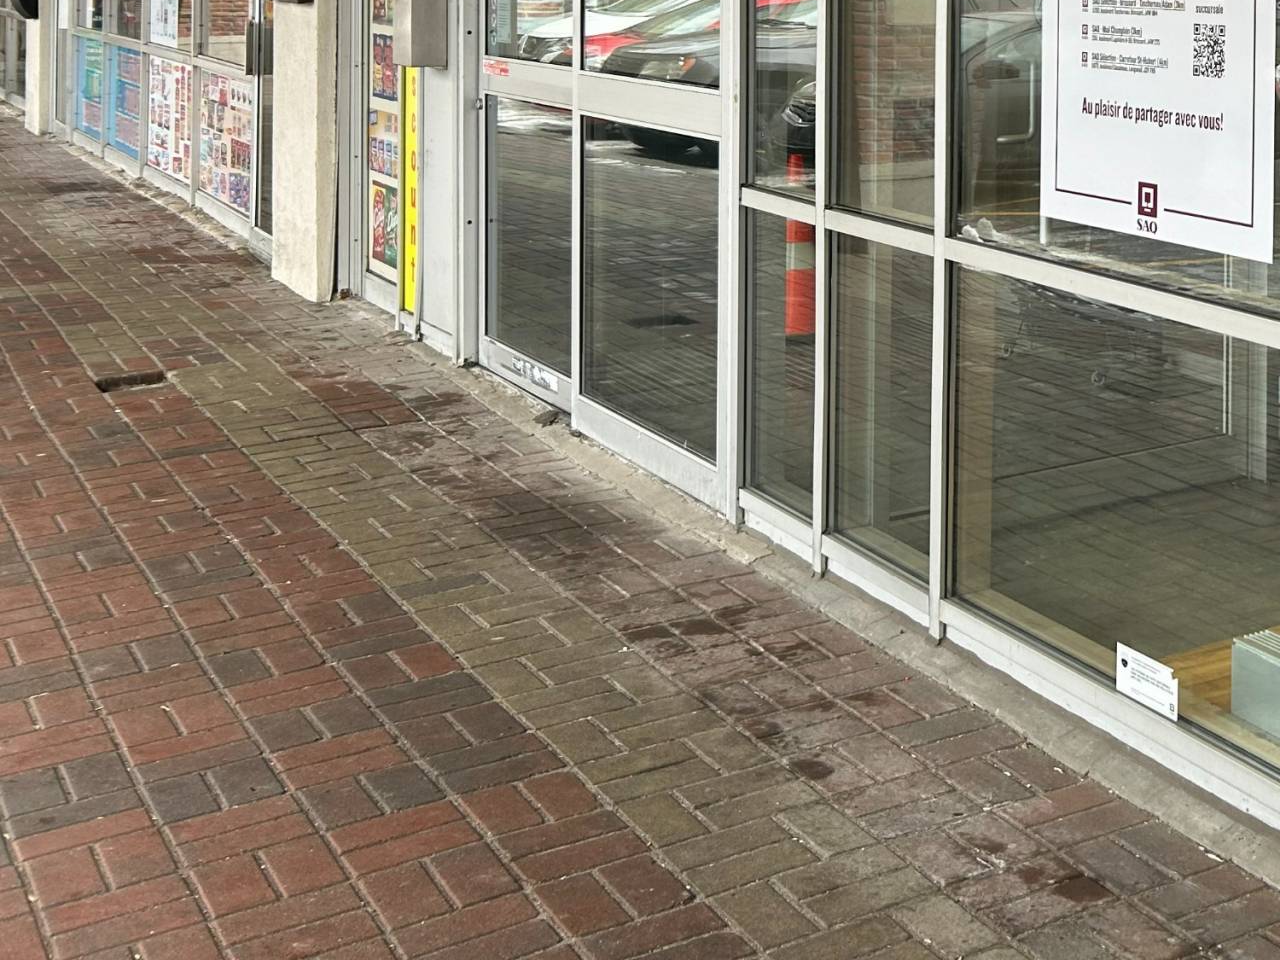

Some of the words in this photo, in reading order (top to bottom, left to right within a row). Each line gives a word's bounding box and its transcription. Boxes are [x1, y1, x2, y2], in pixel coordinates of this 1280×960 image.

[1081, 96, 1093, 115] Au
[1094, 98, 1121, 119] plaisir
[1122, 101, 1133, 120] de
[1134, 106, 1173, 128] partager
[1174, 112, 1196, 128] avec
[1198, 112, 1223, 131] vous!
[1137, 218, 1158, 234] SAQ
